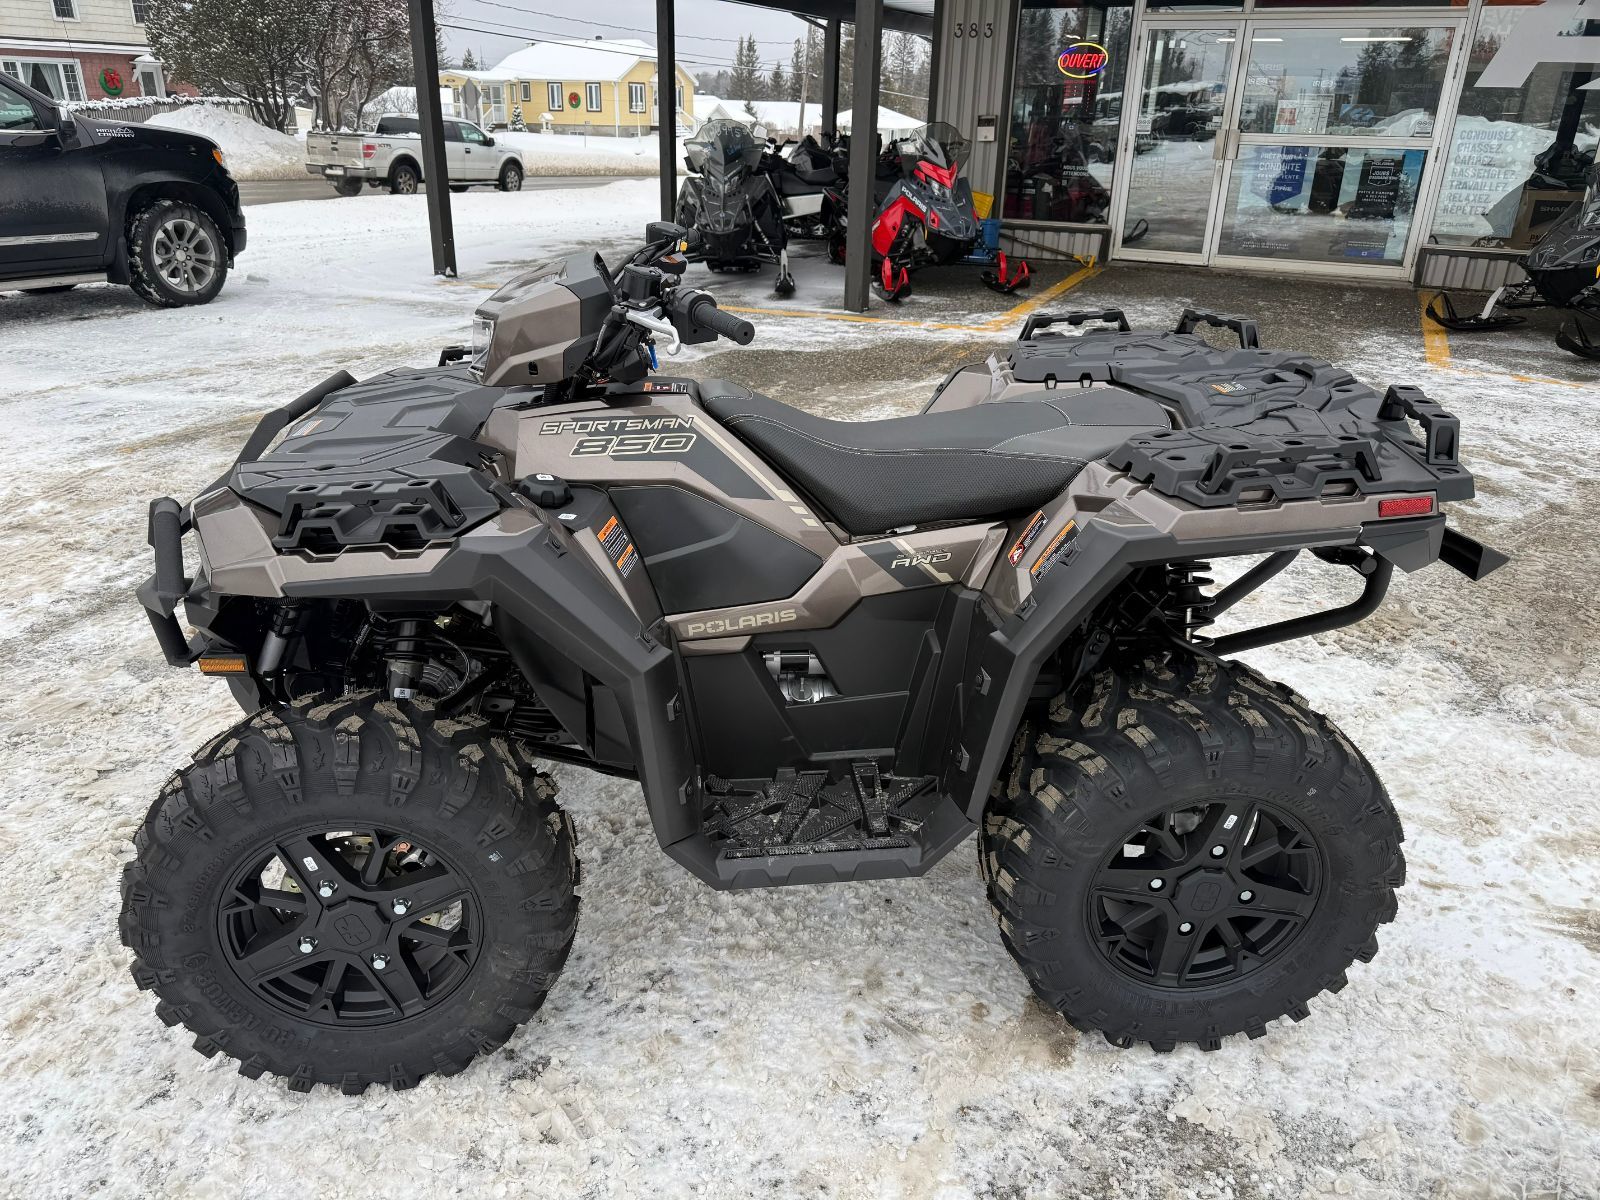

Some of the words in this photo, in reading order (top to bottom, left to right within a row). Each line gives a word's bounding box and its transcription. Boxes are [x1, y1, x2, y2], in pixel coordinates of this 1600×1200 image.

[954, 22, 993, 38] 383
[1060, 53, 1105, 68] OUVERT
[1258, 162, 1302, 172] CONDUITE
[901, 185, 928, 213] POLARIS
[539, 416, 695, 436] SPORTSMAN
[568, 433, 698, 458] 850
[890, 552, 953, 569] AWD
[687, 608, 798, 638] POLARIS
